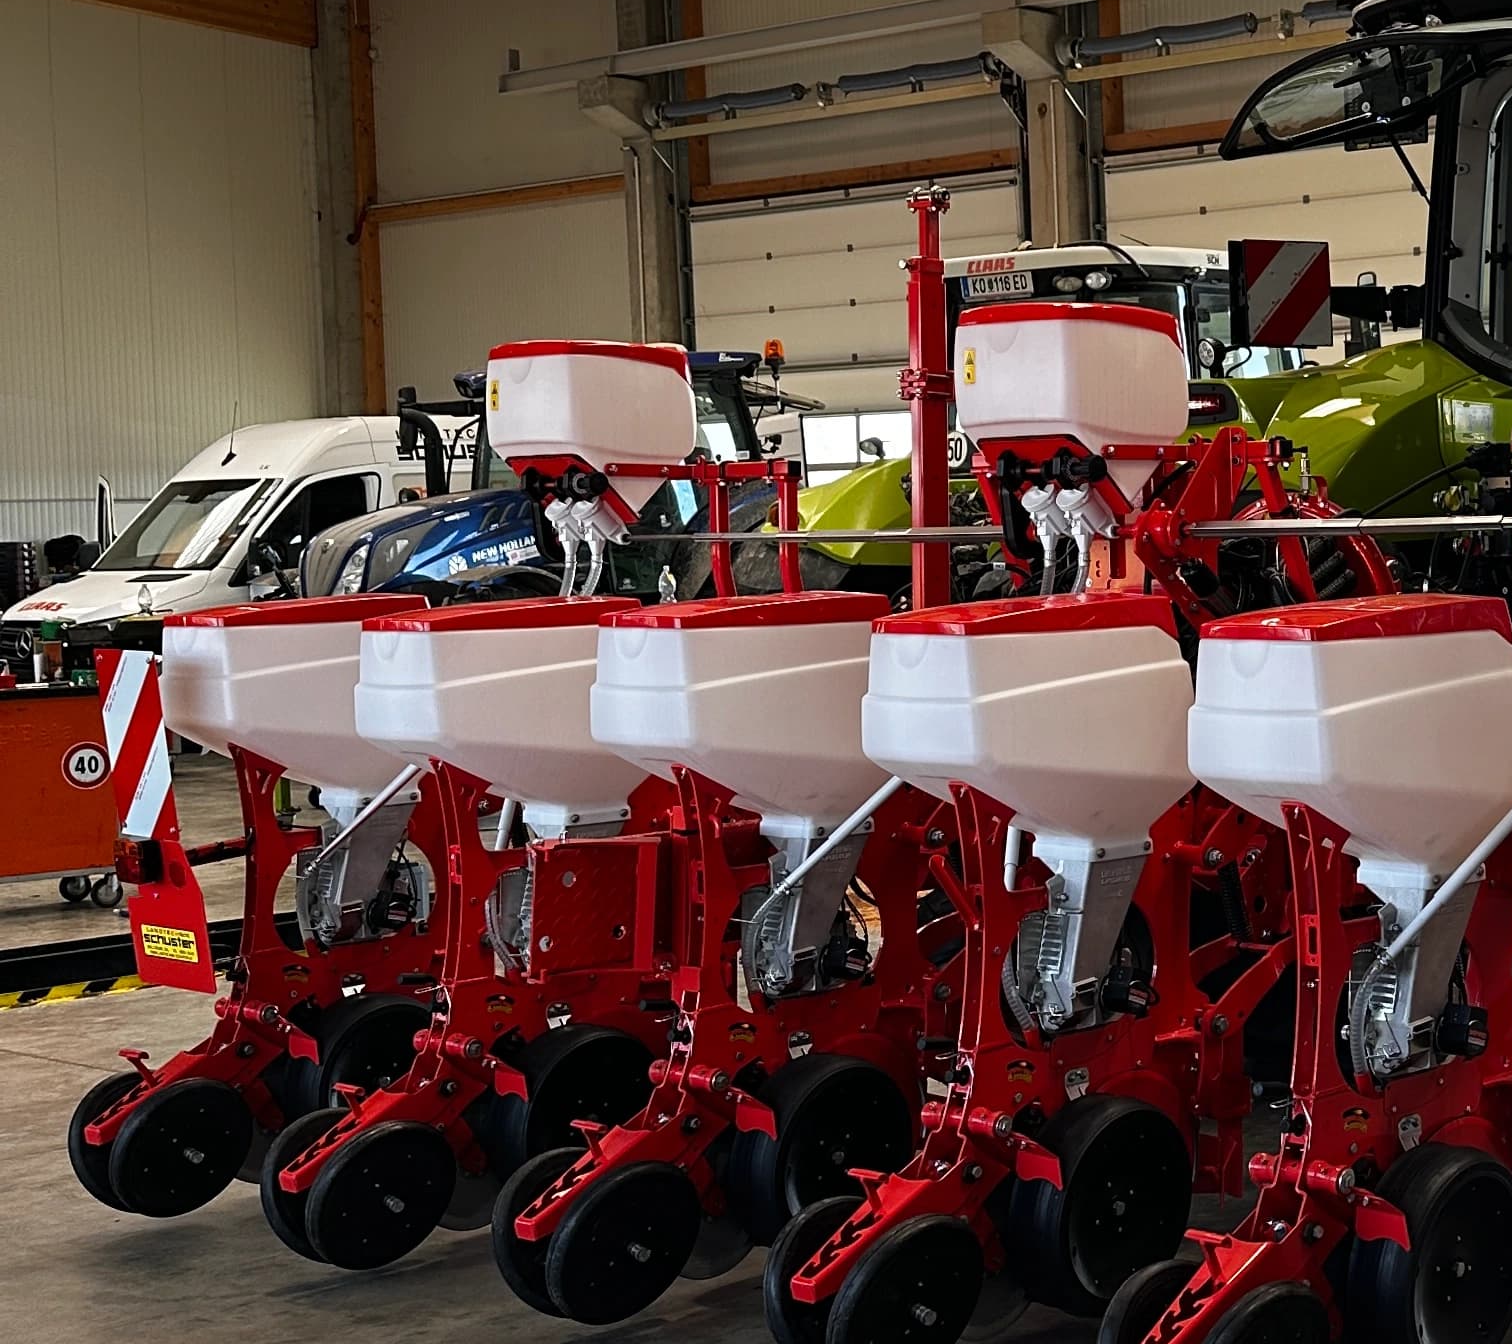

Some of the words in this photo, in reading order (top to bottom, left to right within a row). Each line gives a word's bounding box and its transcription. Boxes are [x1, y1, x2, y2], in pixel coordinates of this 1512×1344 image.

[966, 257, 1016, 274] CLAAS
[993, 274, 1011, 292] 116
[471, 545, 498, 563] NEW
[498, 535, 536, 554] HOLLAN
[74, 755, 99, 775] 40
